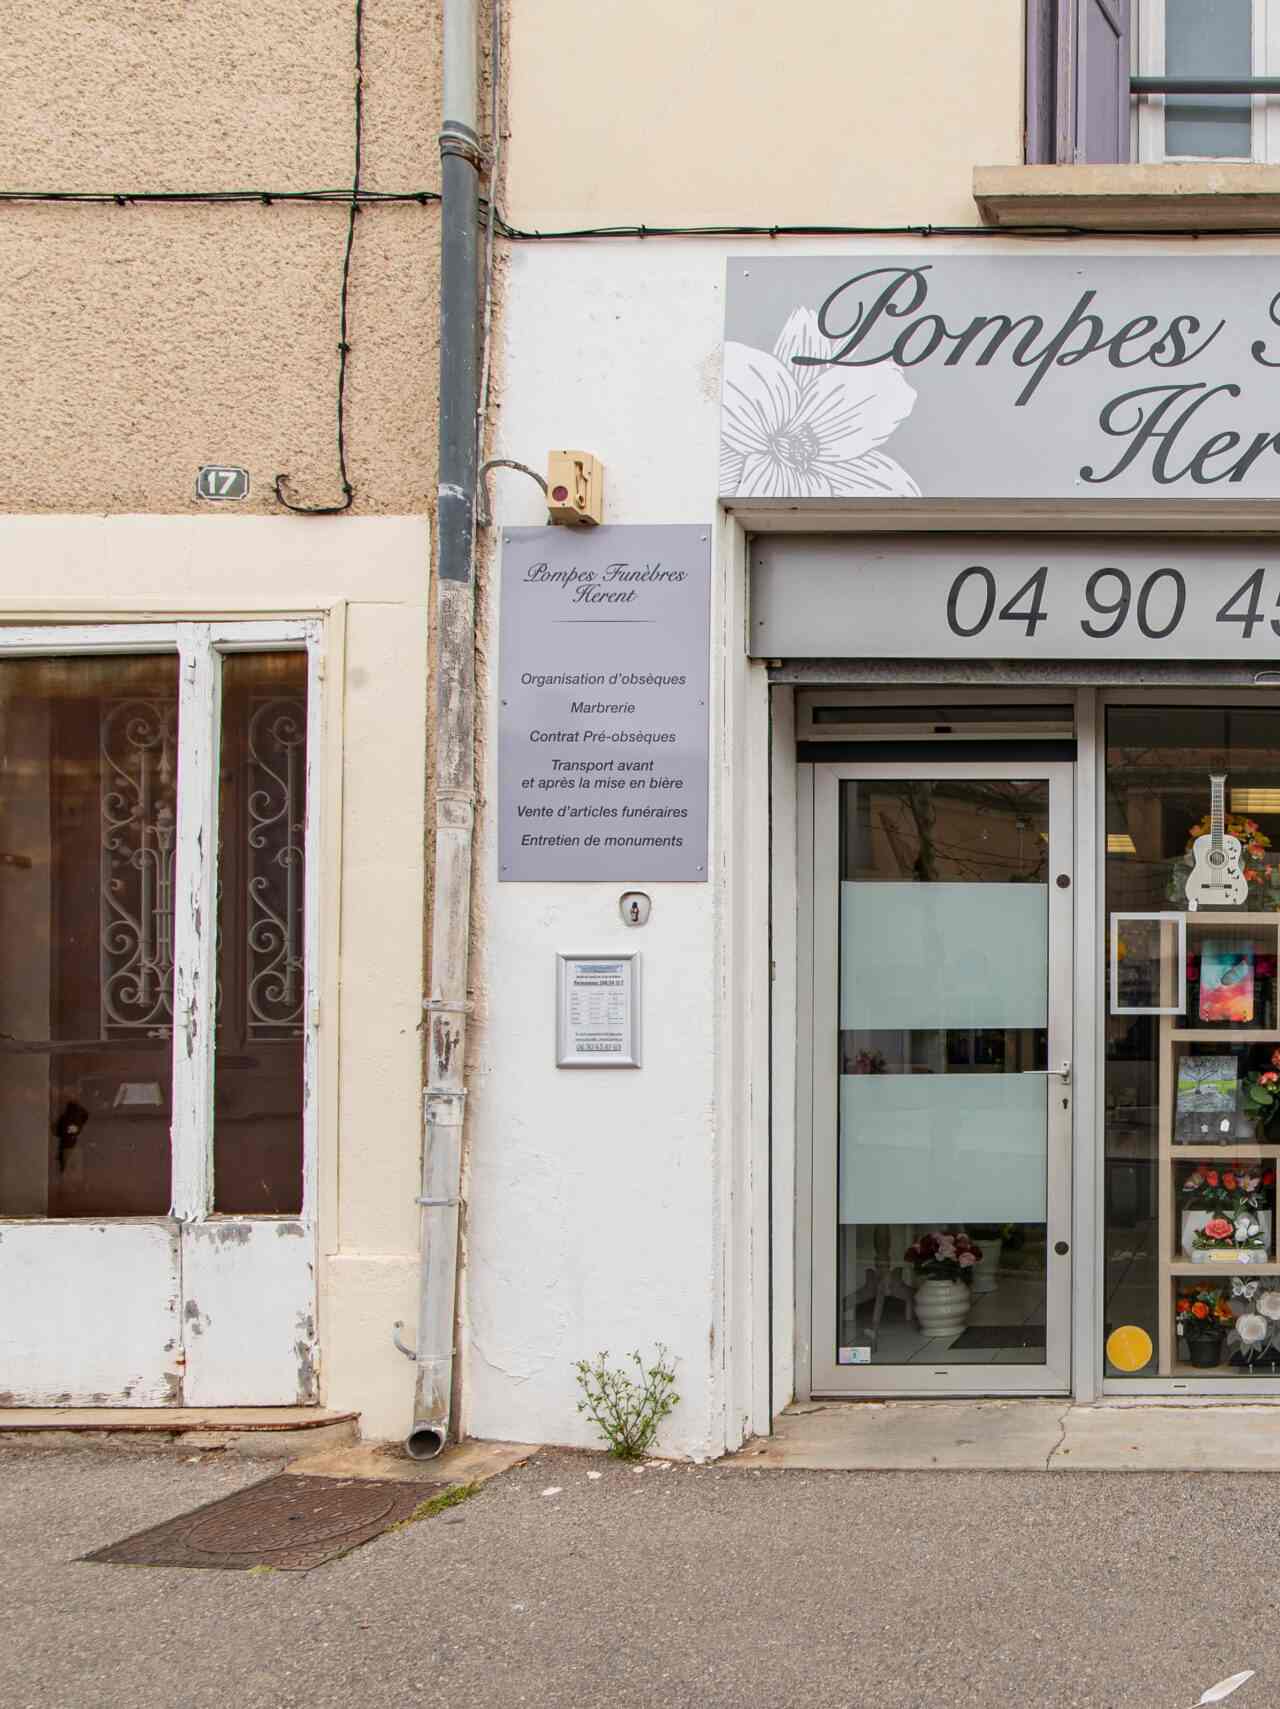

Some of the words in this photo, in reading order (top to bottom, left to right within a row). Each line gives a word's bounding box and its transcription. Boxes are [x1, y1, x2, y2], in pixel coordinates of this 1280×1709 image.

[791, 264, 1224, 406] Pompes
[207, 471, 237, 494] 17
[523, 562, 598, 589] Pompes
[603, 562, 688, 583] Funèbres
[572, 584, 636, 604] Herent
[947, 567, 1048, 639] 04
[1080, 567, 1186, 640] 90
[520, 672, 605, 688] Organisation
[608, 672, 687, 688] d'obsèques
[570, 701, 636, 714] Marbrerie
[529, 729, 580, 744] Contrat
[583, 729, 677, 745] Pré-obsèques
[551, 759, 614, 774] Transport
[616, 761, 655, 772] avant
[521, 777, 536, 790] et
[538, 776, 576, 792] après
[578, 776, 591, 789] la
[593, 777, 627, 789] mise
[629, 779, 646, 789] en
[648, 776, 684, 790] bière
[516, 805, 554, 818] Vente
[556, 805, 618, 818] d'articles
[621, 805, 689, 818] funéraires
[520, 833, 581, 848] Entretien
[583, 834, 601, 847] de
[604, 835, 684, 848] monuments
